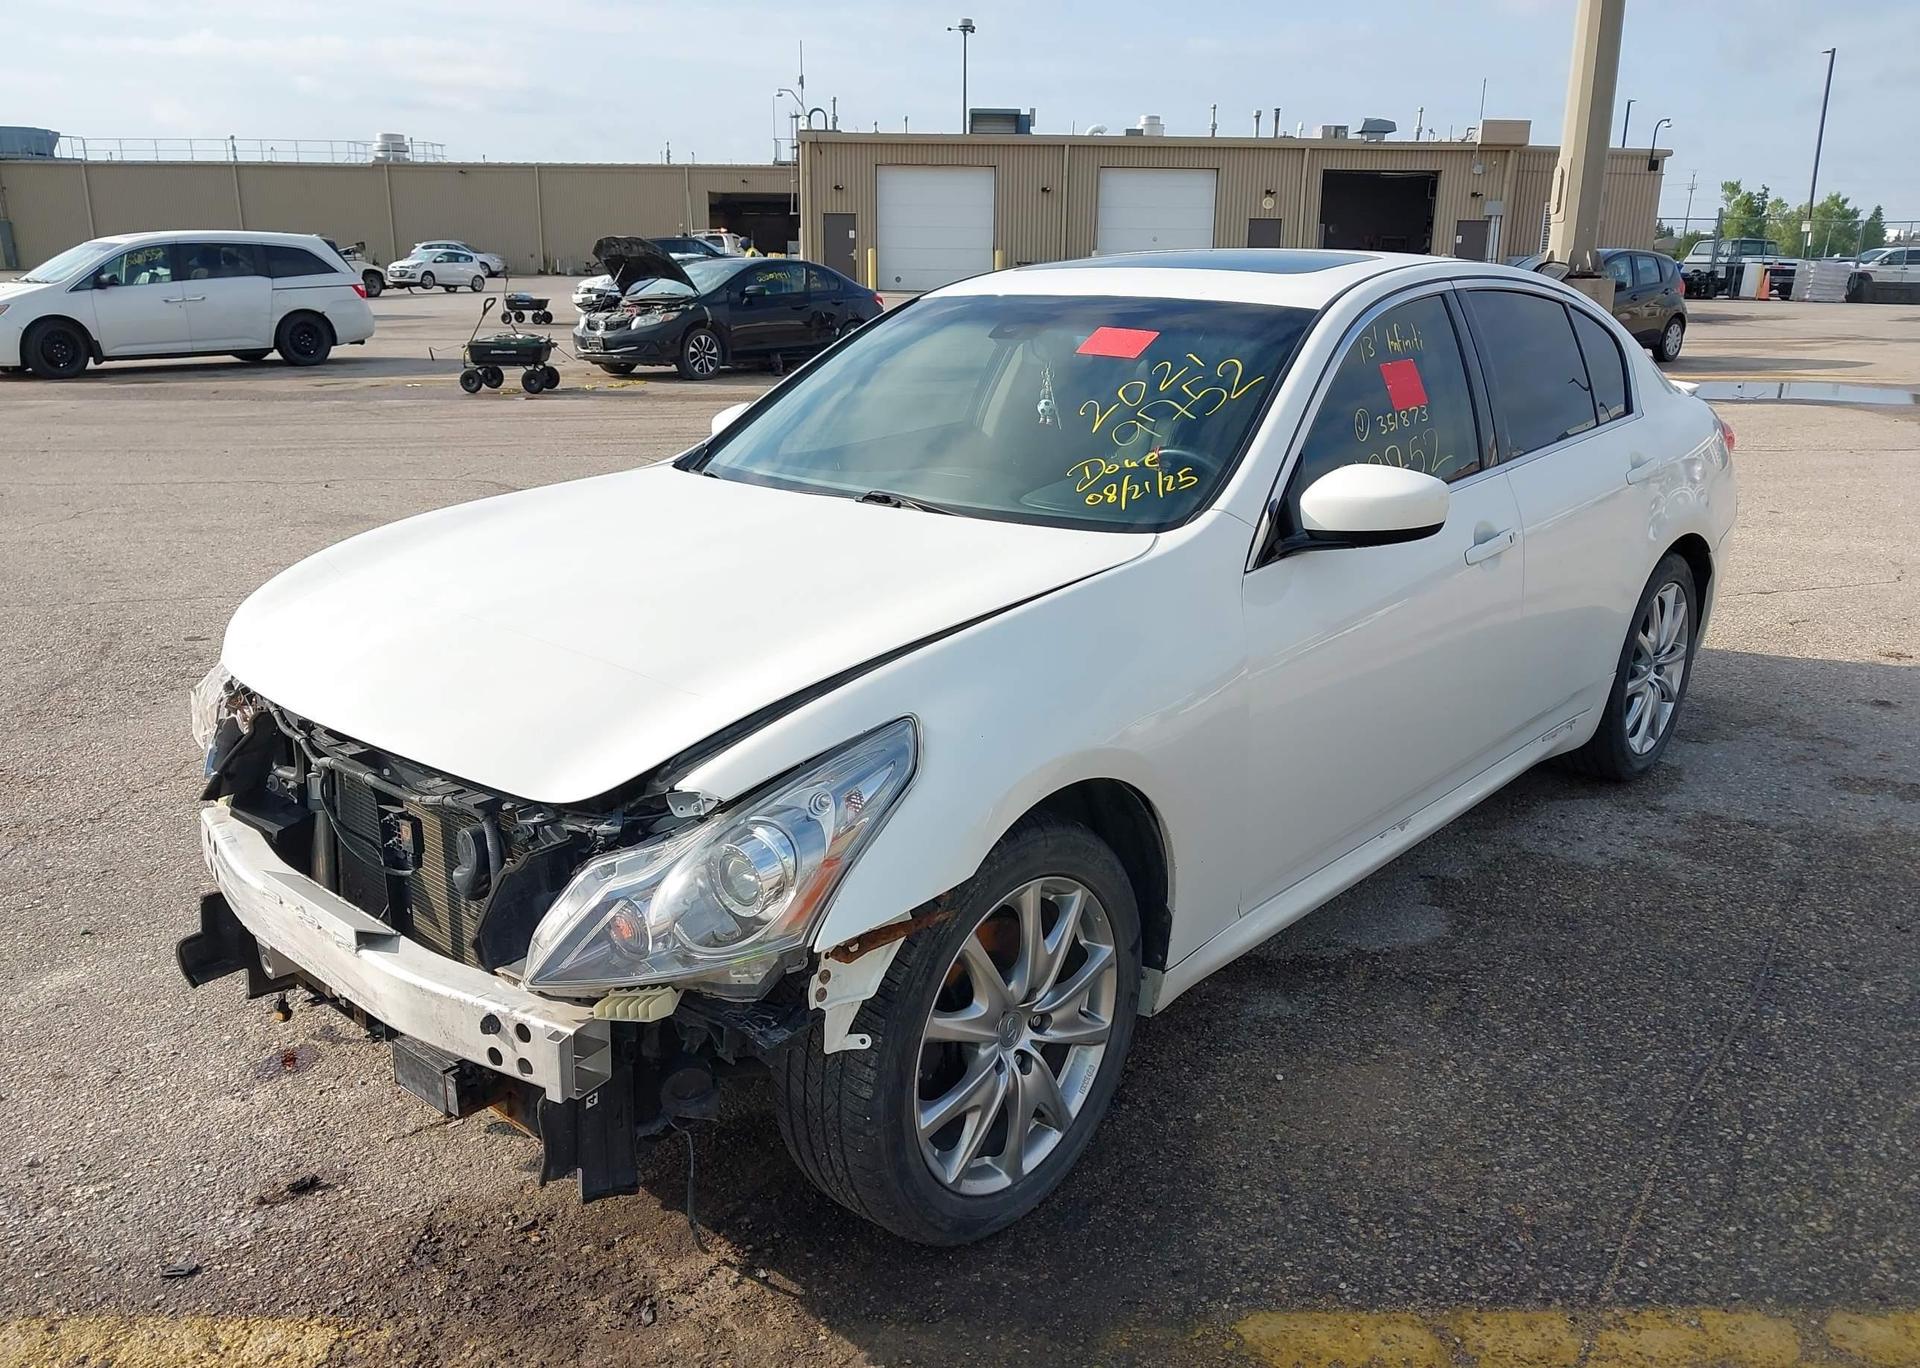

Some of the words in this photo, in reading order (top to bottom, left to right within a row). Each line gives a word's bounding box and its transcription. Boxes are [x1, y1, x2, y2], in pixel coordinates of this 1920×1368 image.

[1385, 323, 1425, 355] Infiniti
[1079, 353, 1205, 434] 2021
[1376, 405, 1429, 435] 351873
[1066, 450, 1160, 493] Done
[1084, 467, 1198, 511] 08/21/25
